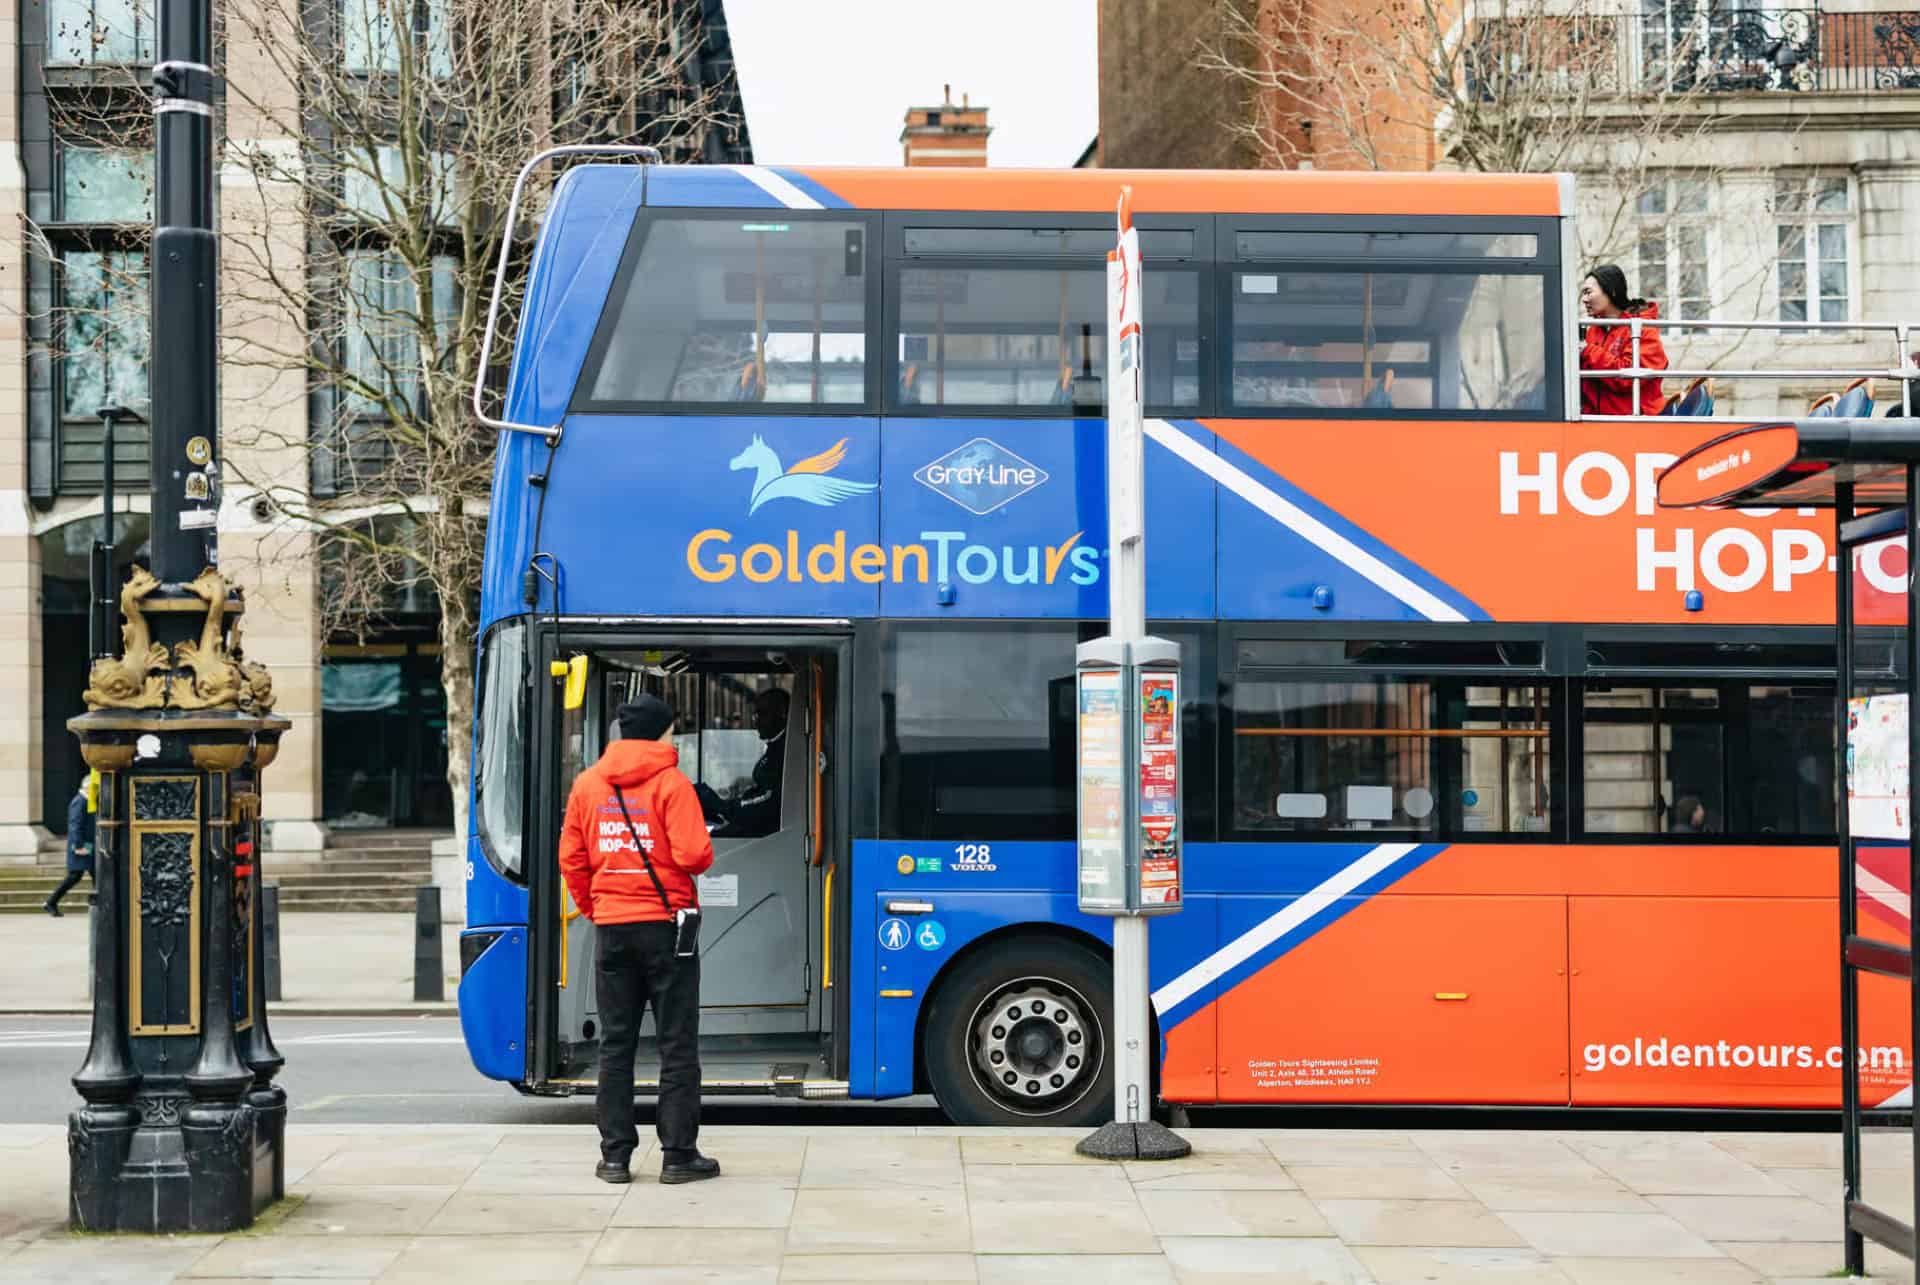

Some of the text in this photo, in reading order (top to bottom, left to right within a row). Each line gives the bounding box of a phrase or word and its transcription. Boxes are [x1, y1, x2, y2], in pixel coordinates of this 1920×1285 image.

[686, 528, 1100, 587] GoldenTours
[950, 863, 998, 873] VOLVO
[954, 844, 991, 865] 128
[1583, 1037, 1903, 1073] goldentours.cm
